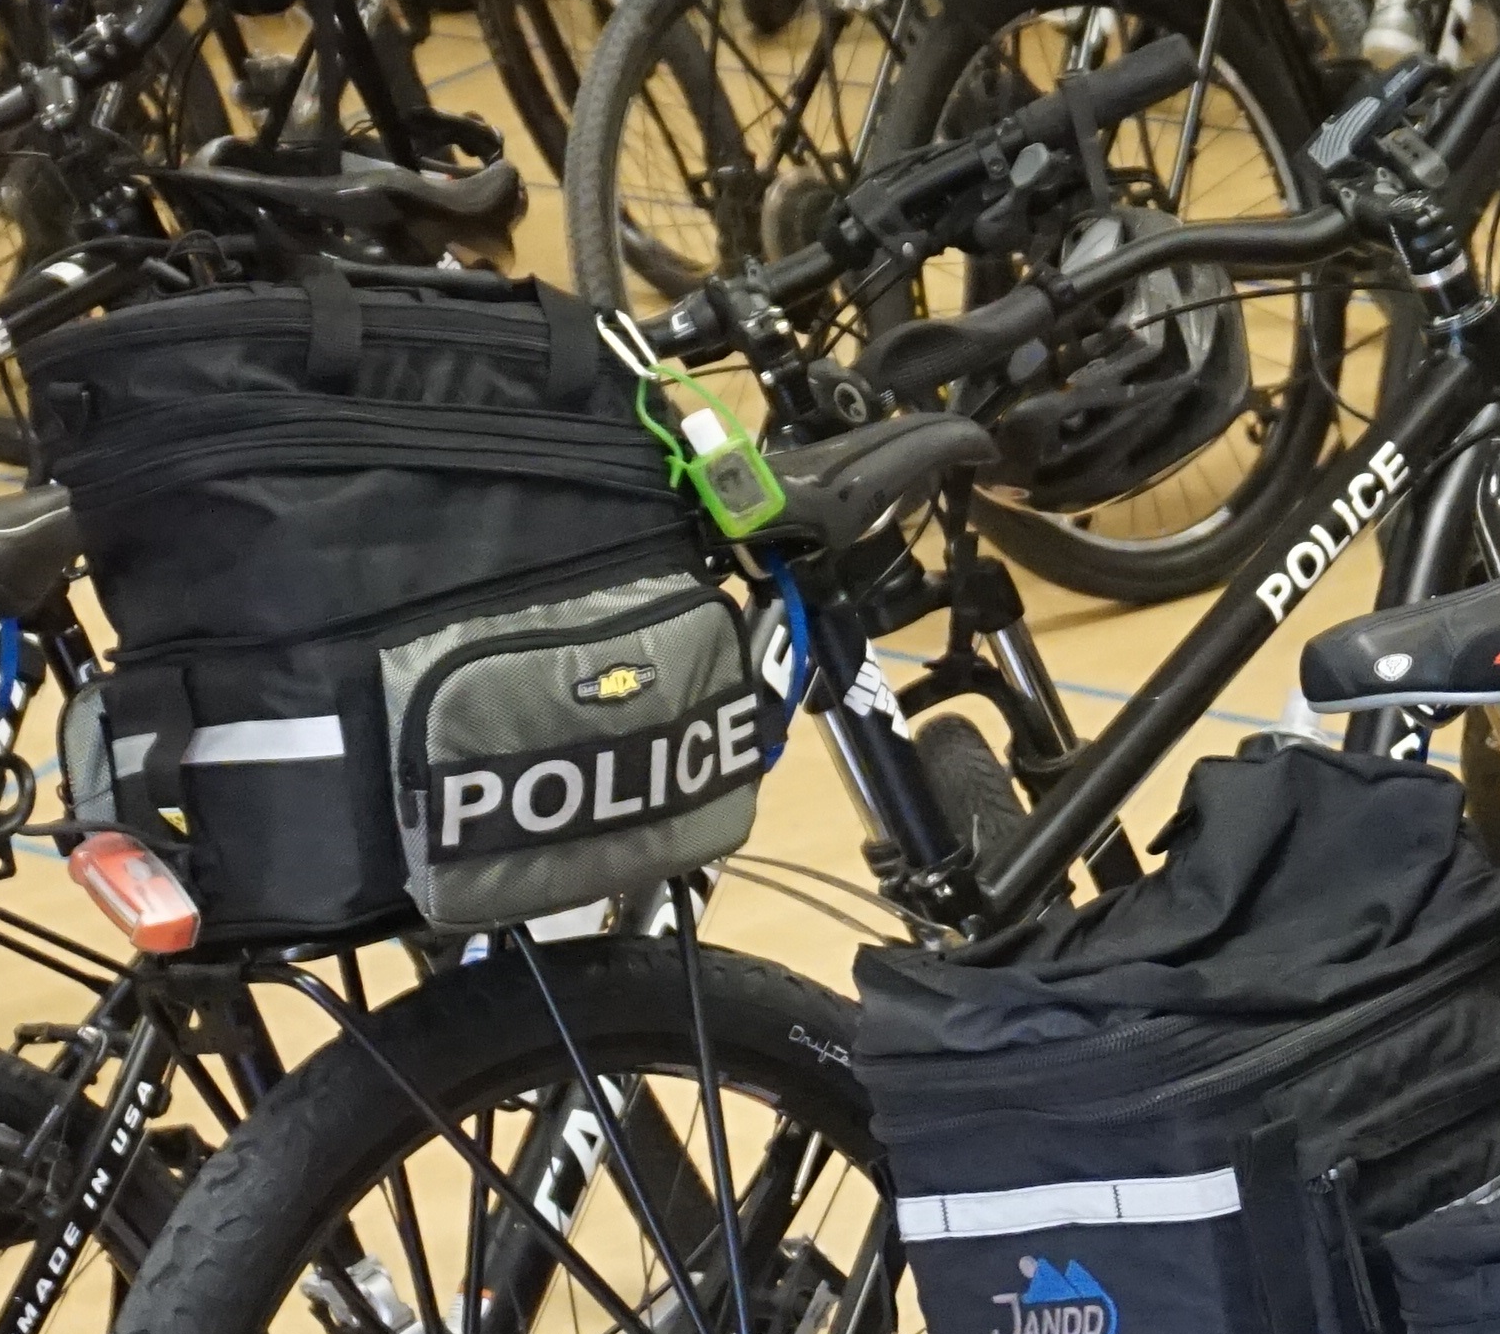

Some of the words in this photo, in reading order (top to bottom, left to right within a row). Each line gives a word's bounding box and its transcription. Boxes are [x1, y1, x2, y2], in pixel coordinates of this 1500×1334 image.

[1254, 440, 1410, 625] POLICE
[599, 669, 639, 697] MTX
[440, 693, 760, 846] POLICE
[788, 1024, 852, 1068] Drifte
[82, 1166, 113, 1213] IN
[109, 1078, 157, 1154] USA
